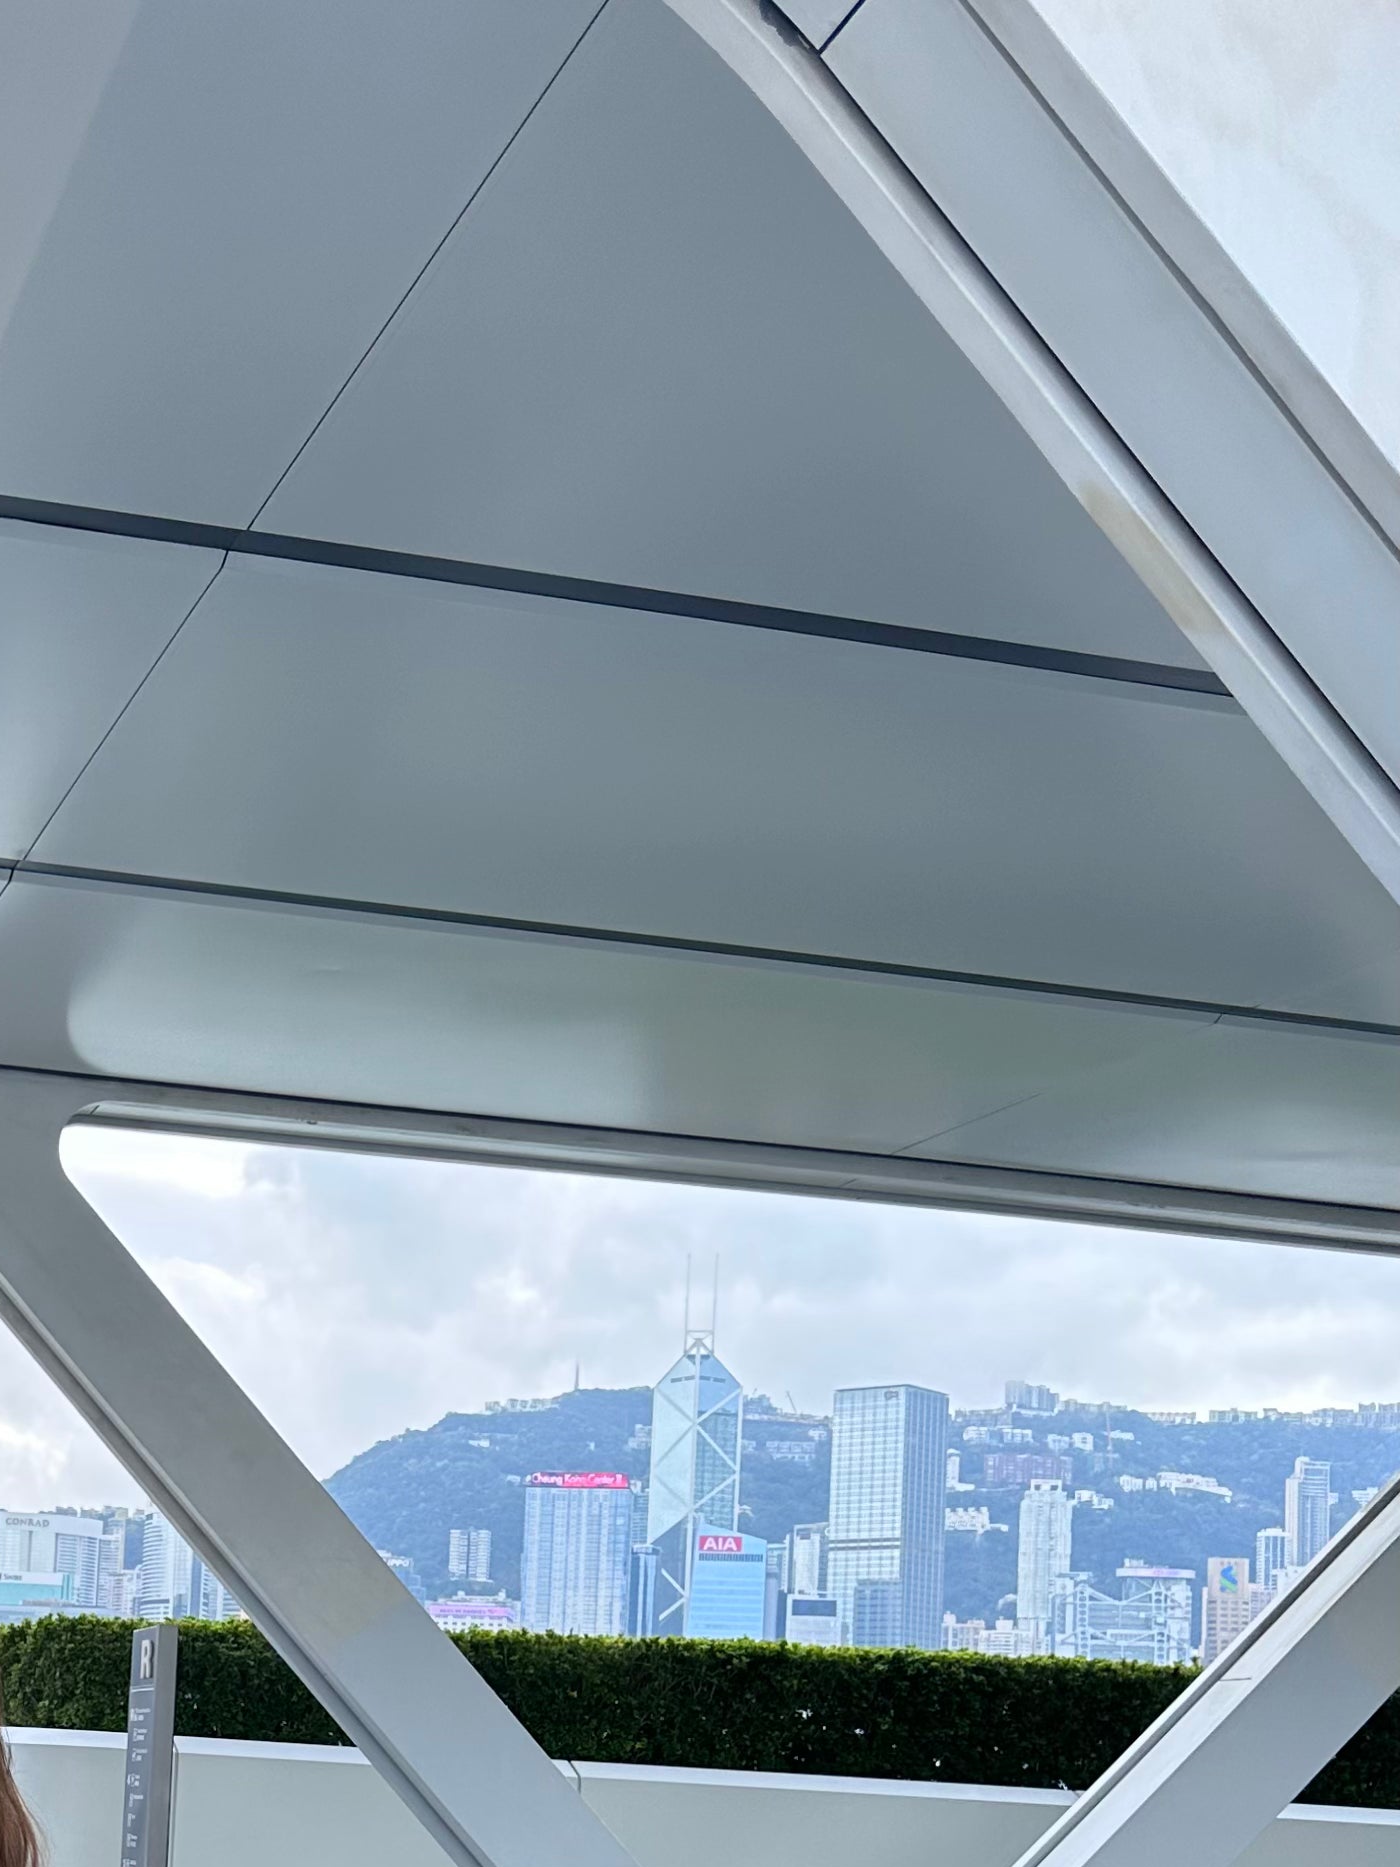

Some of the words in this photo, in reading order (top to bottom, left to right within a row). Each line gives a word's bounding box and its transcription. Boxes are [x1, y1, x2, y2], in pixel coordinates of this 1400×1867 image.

[5, 1517, 50, 1528] CONRAD
[702, 1536, 738, 1551] AIA
[140, 1638, 154, 1680] R
